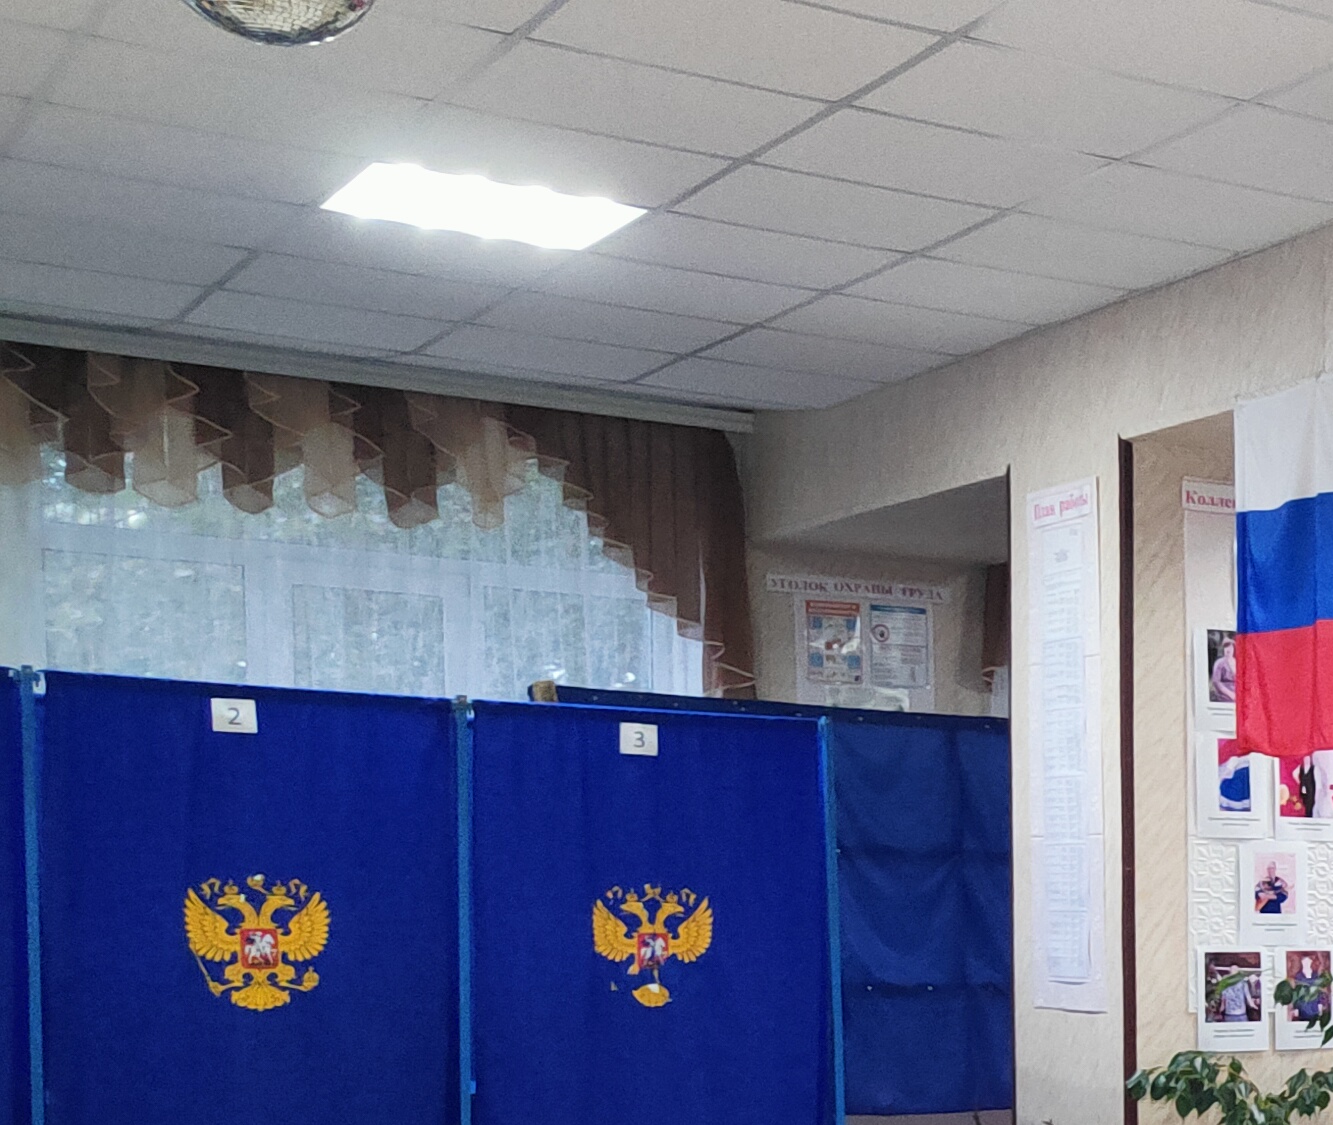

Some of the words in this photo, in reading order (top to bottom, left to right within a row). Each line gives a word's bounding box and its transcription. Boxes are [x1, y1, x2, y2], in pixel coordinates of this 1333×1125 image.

[770, 578, 828, 592] УГОЛОК
[834, 581, 893, 595] ОХРАНЫ
[901, 586, 943, 599] ТРУДА
[228, 707, 241, 725] 2
[633, 731, 645, 748] 3
